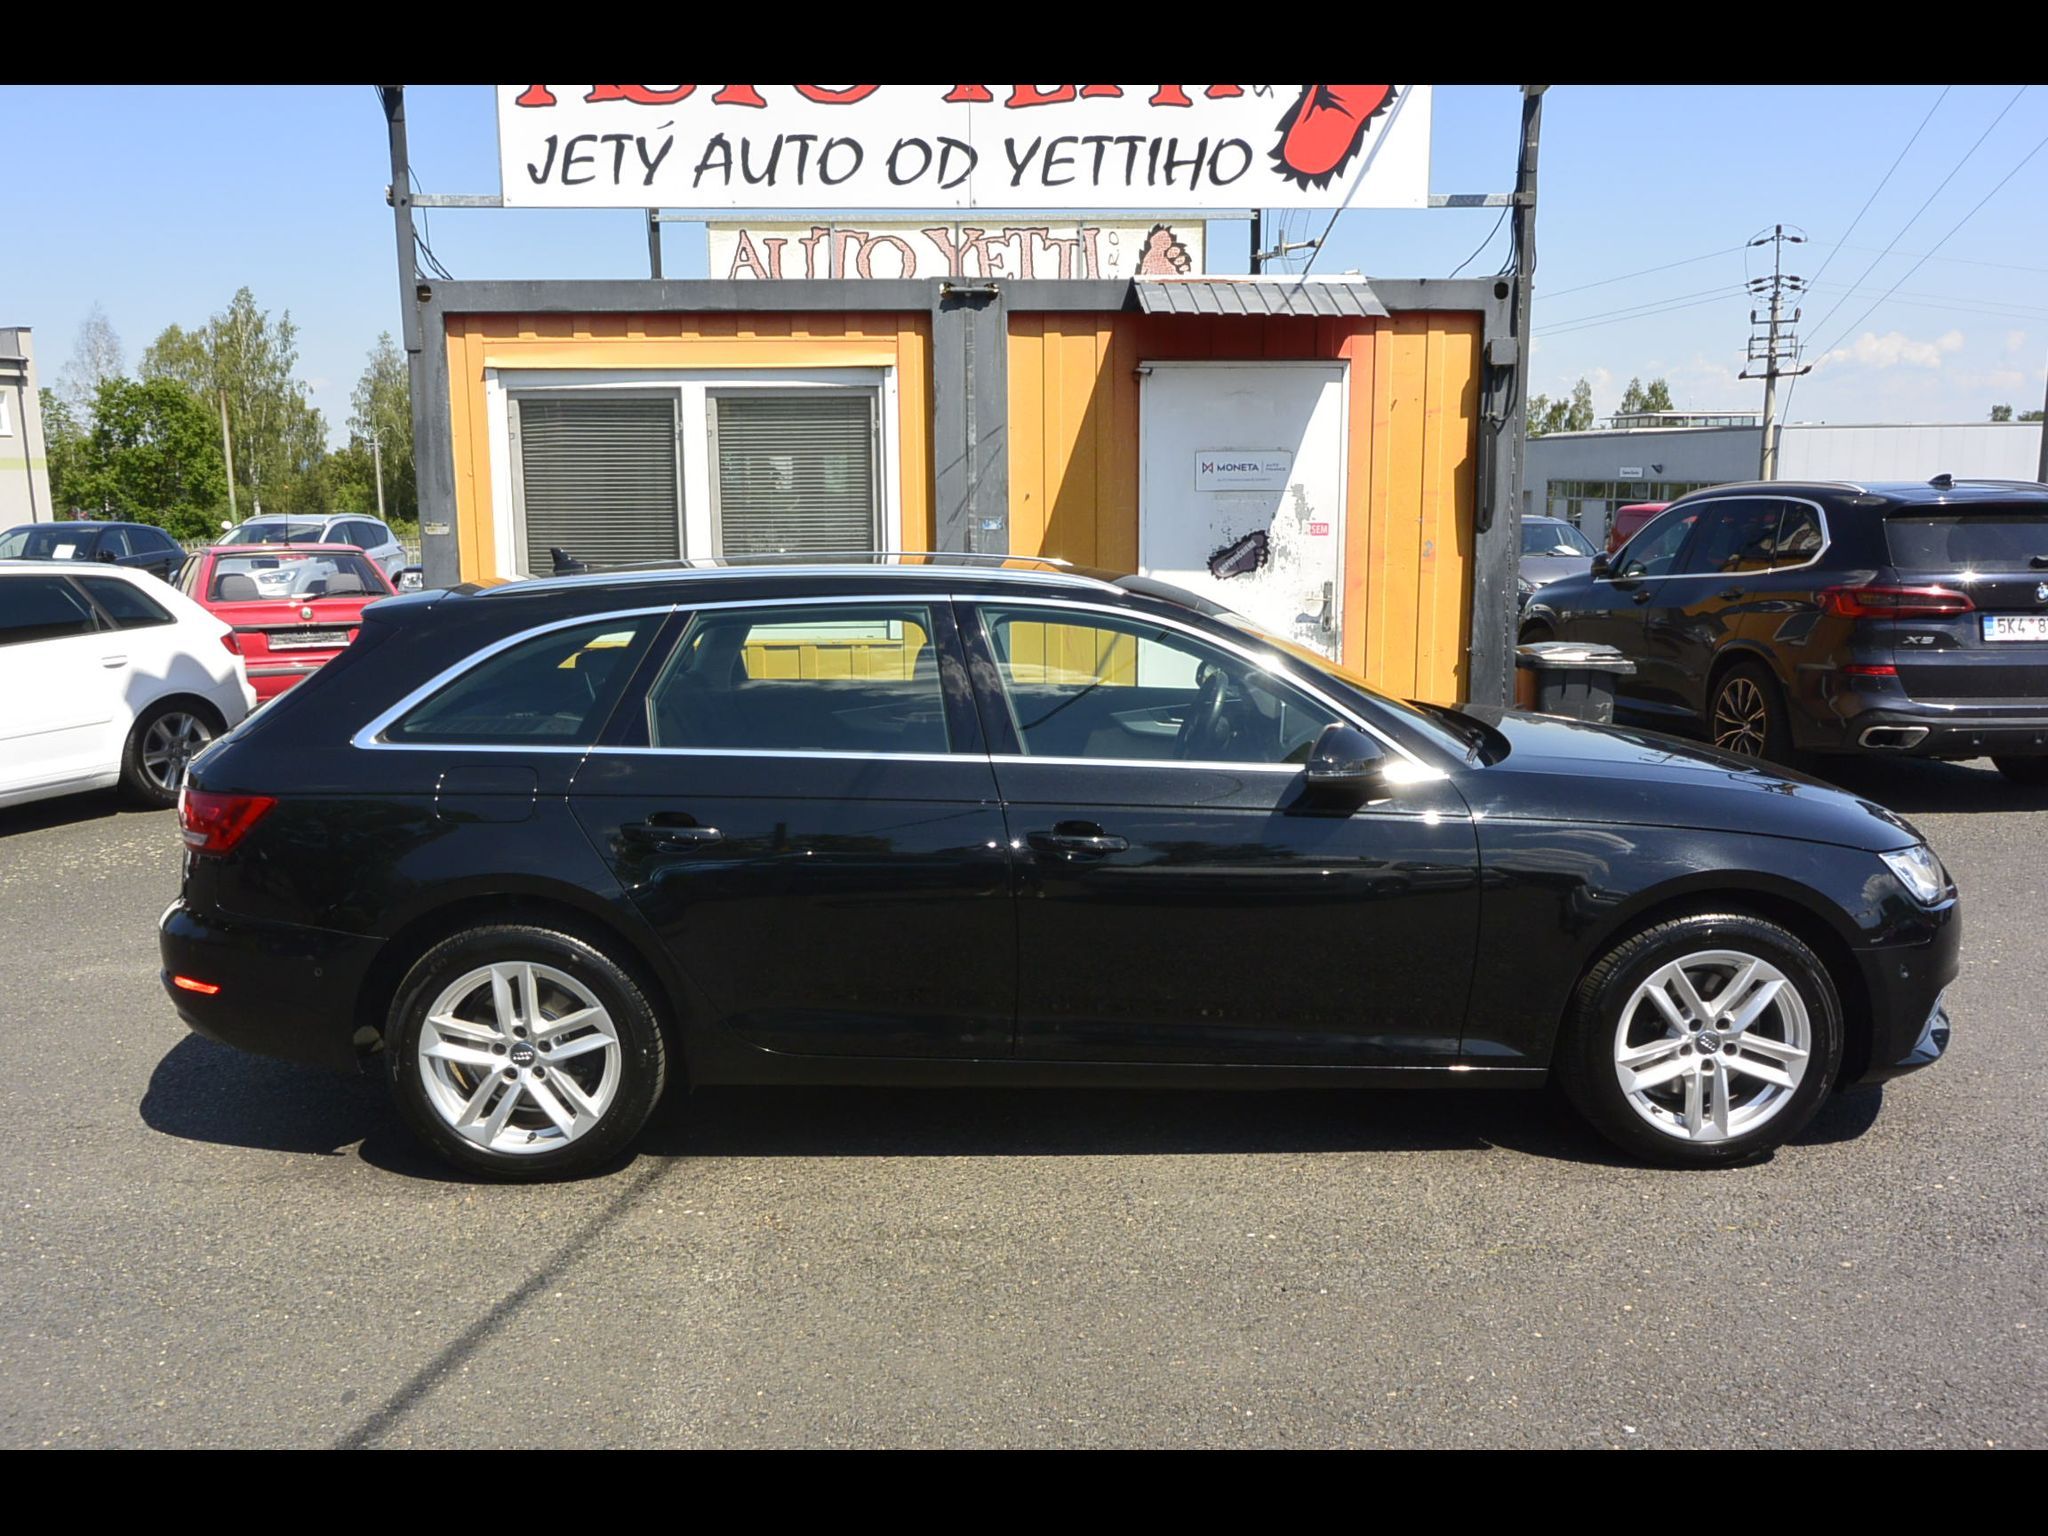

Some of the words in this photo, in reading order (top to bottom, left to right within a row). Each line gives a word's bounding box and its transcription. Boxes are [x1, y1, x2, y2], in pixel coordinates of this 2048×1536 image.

[527, 120, 674, 185] JETÝ
[693, 132, 864, 188] AUTO
[885, 135, 978, 189] OD
[1004, 136, 1253, 191] YETTIHO
[1217, 463, 1259, 472] MONETA
[1997, 617, 2026, 634] 5K4
[2038, 617, 2048, 634] 8
[1902, 636, 1936, 644] X5
